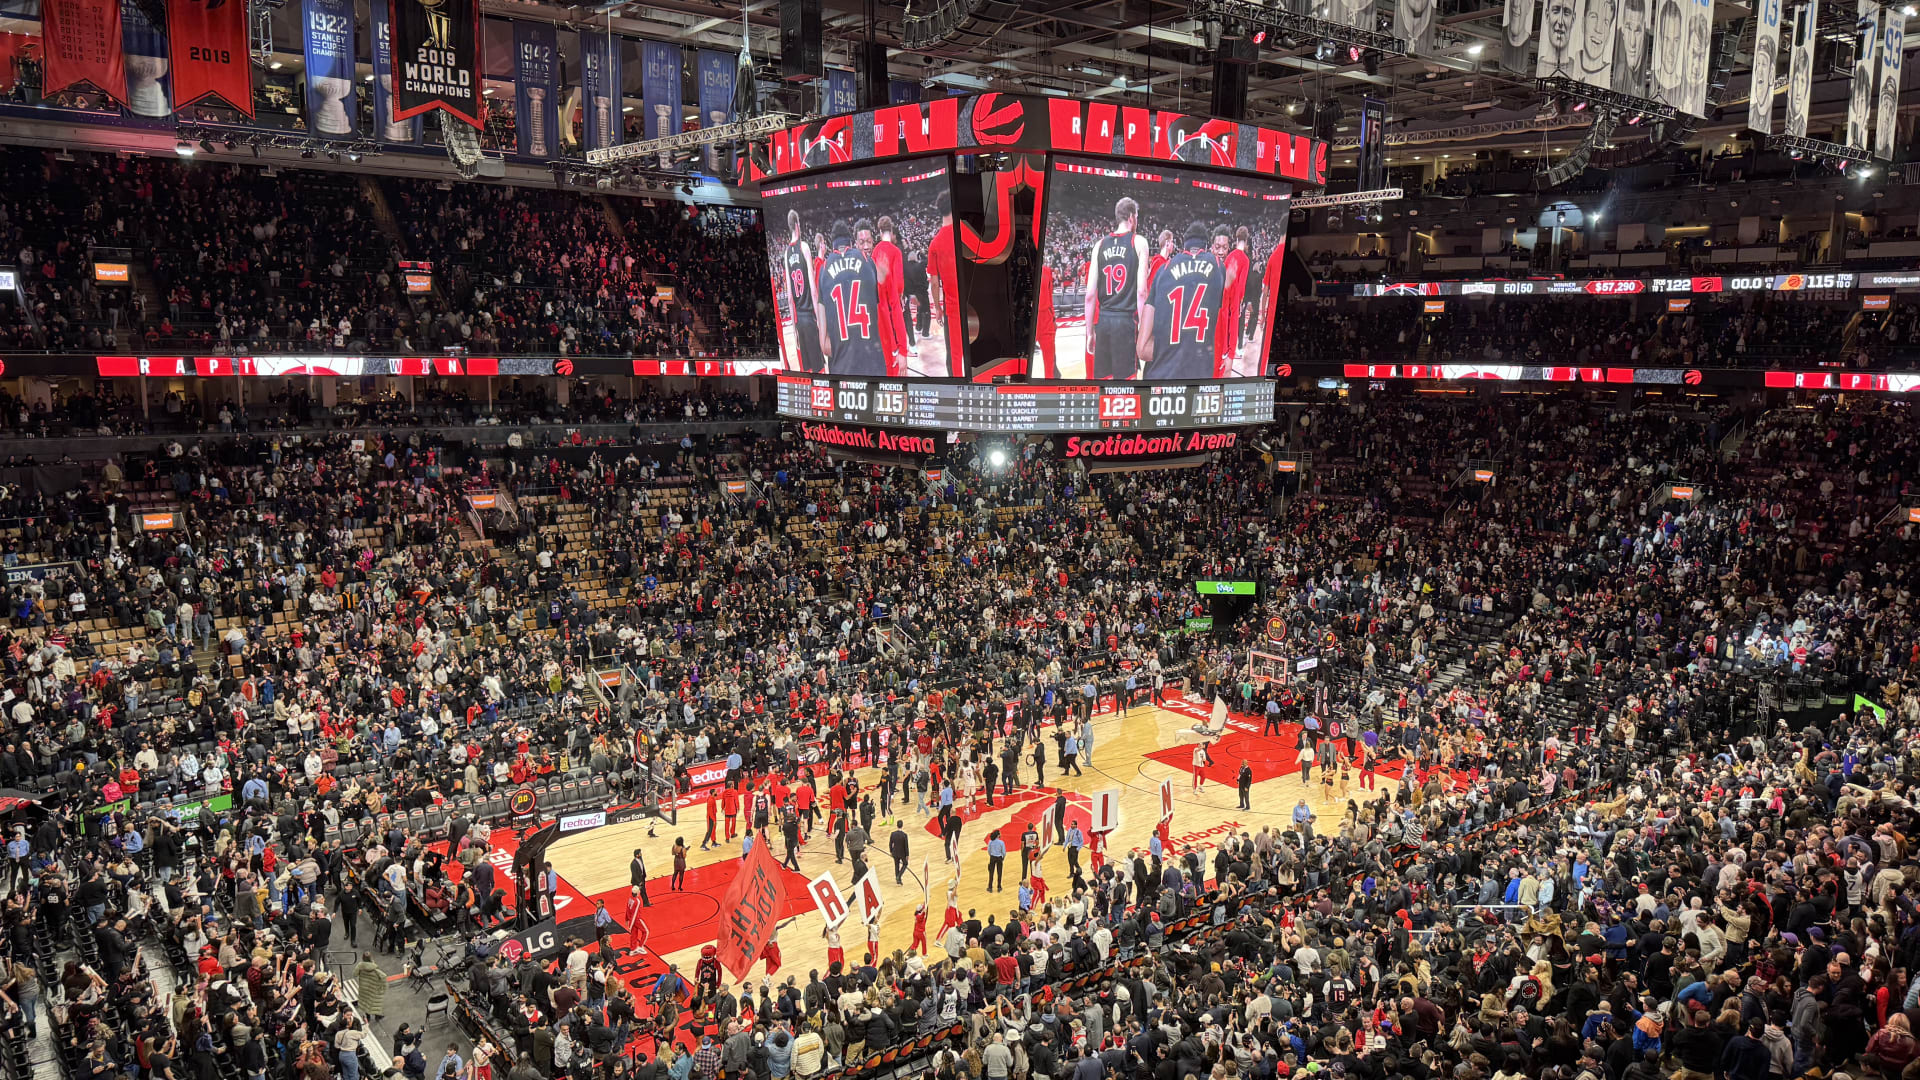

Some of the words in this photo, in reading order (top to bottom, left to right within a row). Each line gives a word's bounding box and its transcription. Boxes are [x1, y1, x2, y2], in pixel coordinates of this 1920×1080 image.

[309, 11, 347, 35] 1922
[311, 31, 346, 44] STANLEY
[322, 42, 337, 50] CUP
[190, 47, 230, 64] 2019
[417, 48, 456, 67] 2019
[520, 42, 550, 63] 1942
[1884, 27, 1903, 70] 93
[405, 62, 470, 86] WORLD
[648, 62, 676, 81] 1947
[704, 70, 730, 88] 1948
[405, 80, 471, 98] CHAMPIONS
[874, 117, 929, 143] WIN
[1367, 119, 1381, 144] 15
[1072, 116, 1229, 151] RAPTORS
[1256, 141, 1295, 164] WIN
[828, 257, 862, 279] WALTER
[1170, 260, 1213, 281] WALTER
[791, 268, 804, 298] 19
[1102, 263, 1127, 296] 19
[1595, 280, 1636, 292] $57,290
[1666, 278, 1692, 292] 122
[1731, 277, 1762, 290] 00.0
[1807, 275, 1835, 289] 115
[1800, 288, 1850, 301] STREET
[830, 279, 871, 341] 14
[1167, 283, 1209, 345] 14
[389, 359, 457, 375] WIN
[1543, 366, 1599, 381] WIN
[847, 381, 868, 390] TISSOT
[879, 383, 903, 391] PHOENIX
[1162, 386, 1187, 394] TISSOT
[1199, 385, 1221, 393] PHOENIX
[812, 389, 832, 408] 122
[839, 391, 867, 411] 00.0
[877, 393, 903, 413] 115
[1102, 397, 1136, 417] 122
[1149, 396, 1186, 415] 00.0
[1196, 395, 1220, 414] 115
[801, 421, 876, 448] Scotiabank
[879, 430, 936, 454] Arena
[1066, 431, 1183, 457] Scotiabank
[1187, 431, 1237, 451] Arena
[7, 570, 33, 582] IBM
[43, 566, 69, 577] IBM
[617, 815, 632, 823] Uber
[632, 812, 646, 821] Eats
[813, 879, 845, 922] R
[862, 878, 880, 919] A
[526, 931, 555, 954] LG
[1334, 990, 1345, 1001] 15
